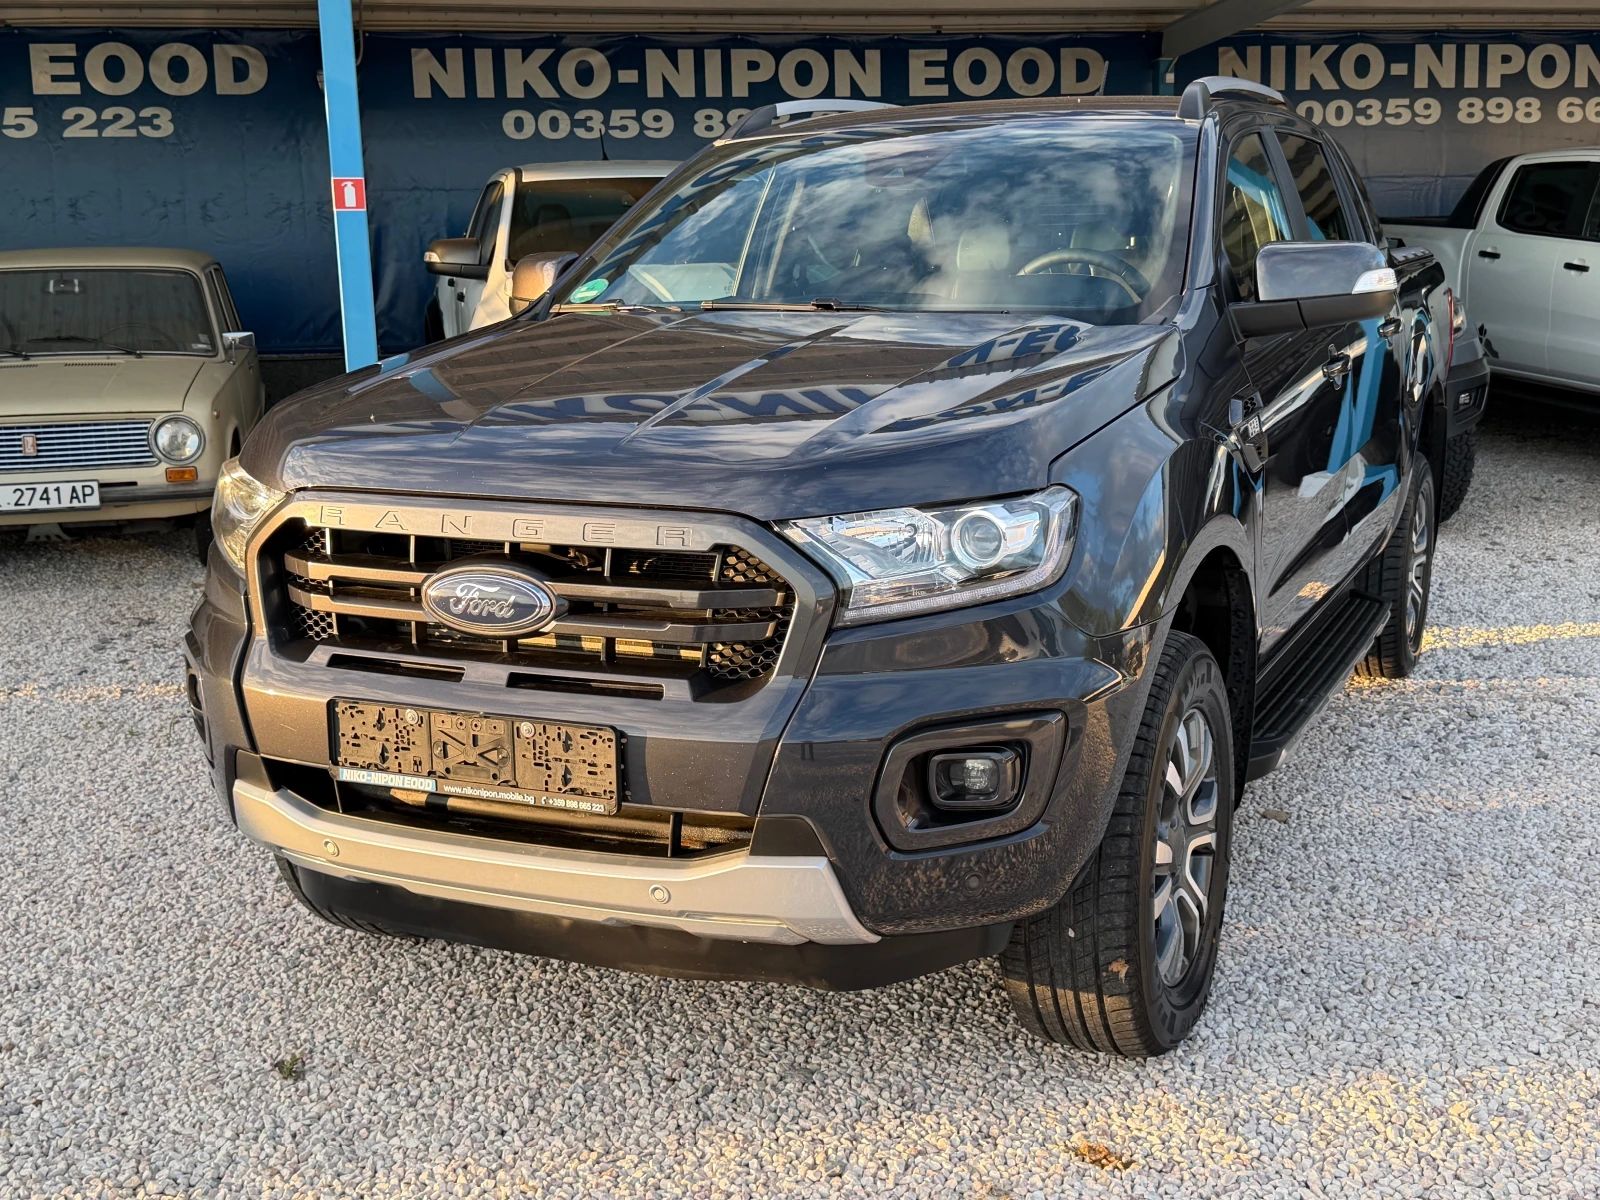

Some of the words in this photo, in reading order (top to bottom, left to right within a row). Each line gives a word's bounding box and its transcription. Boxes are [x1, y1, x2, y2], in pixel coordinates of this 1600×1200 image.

[29, 42, 269, 96] EOOD
[410, 47, 882, 99] NIKO-NIPON
[908, 47, 1106, 97] EOOD
[62, 107, 175, 138] 223
[502, 109, 675, 140] 00359
[1296, 97, 1441, 128] 00359
[1457, 97, 1542, 125] 898
[69, 484, 95, 504] AP
[320, 505, 693, 548] RANGER
[449, 582, 516, 619] Ford
[343, 769, 403, 786] NIKO-NIPON
[404, 778, 433, 791] EOOD
[443, 784, 535, 804] www.nikonipon.mobile.bg
[592, 803, 605, 812] 223
